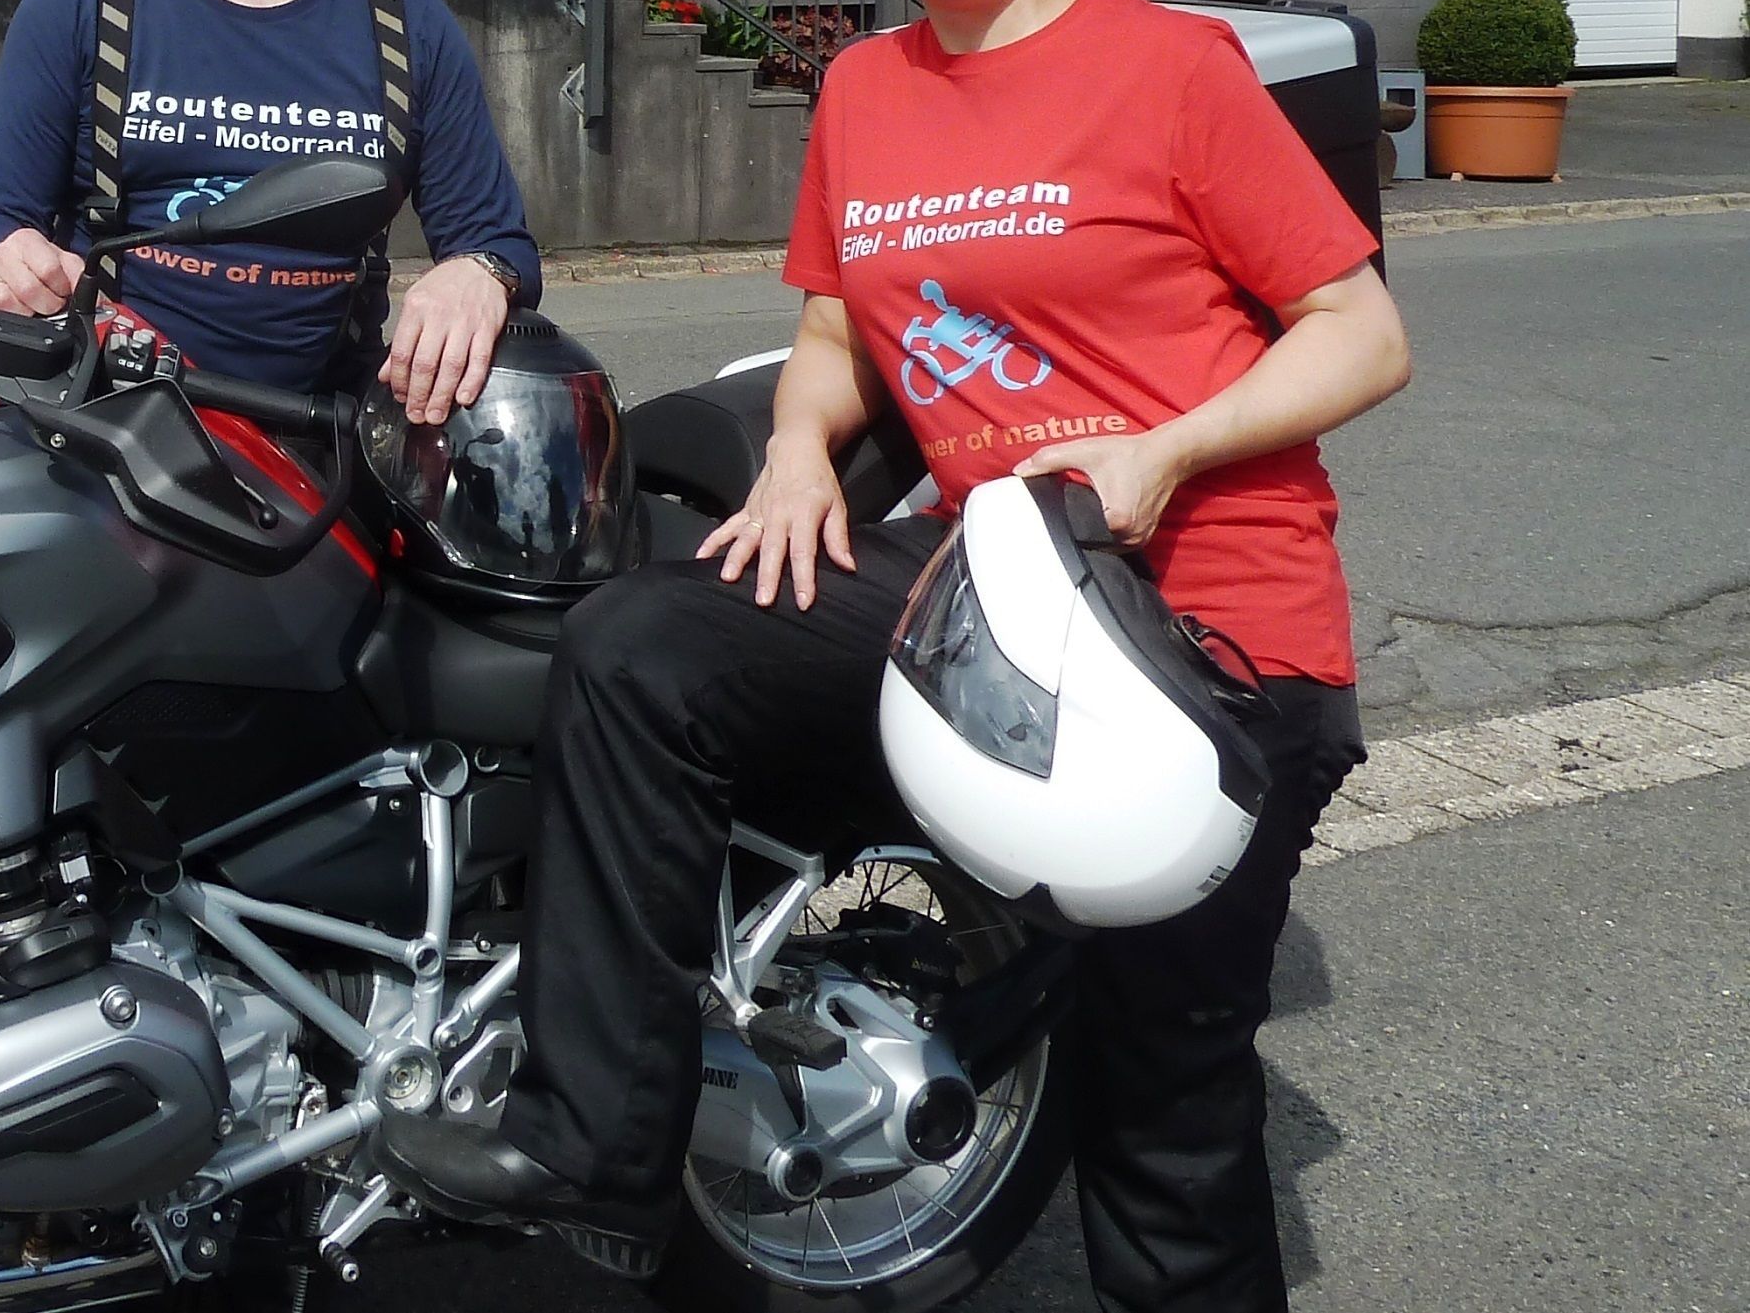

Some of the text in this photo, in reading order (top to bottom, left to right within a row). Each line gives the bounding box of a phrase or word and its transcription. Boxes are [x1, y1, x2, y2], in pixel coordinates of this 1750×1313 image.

[122, 116, 186, 144] Eifel
[127, 90, 384, 132] Routenteam
[843, 181, 1070, 229] Routenteam
[841, 231, 883, 264] Eifel
[901, 211, 1066, 252] Motorrad.de
[125, 244, 356, 286] ower of nature
[922, 414, 1128, 460] wer of nature
